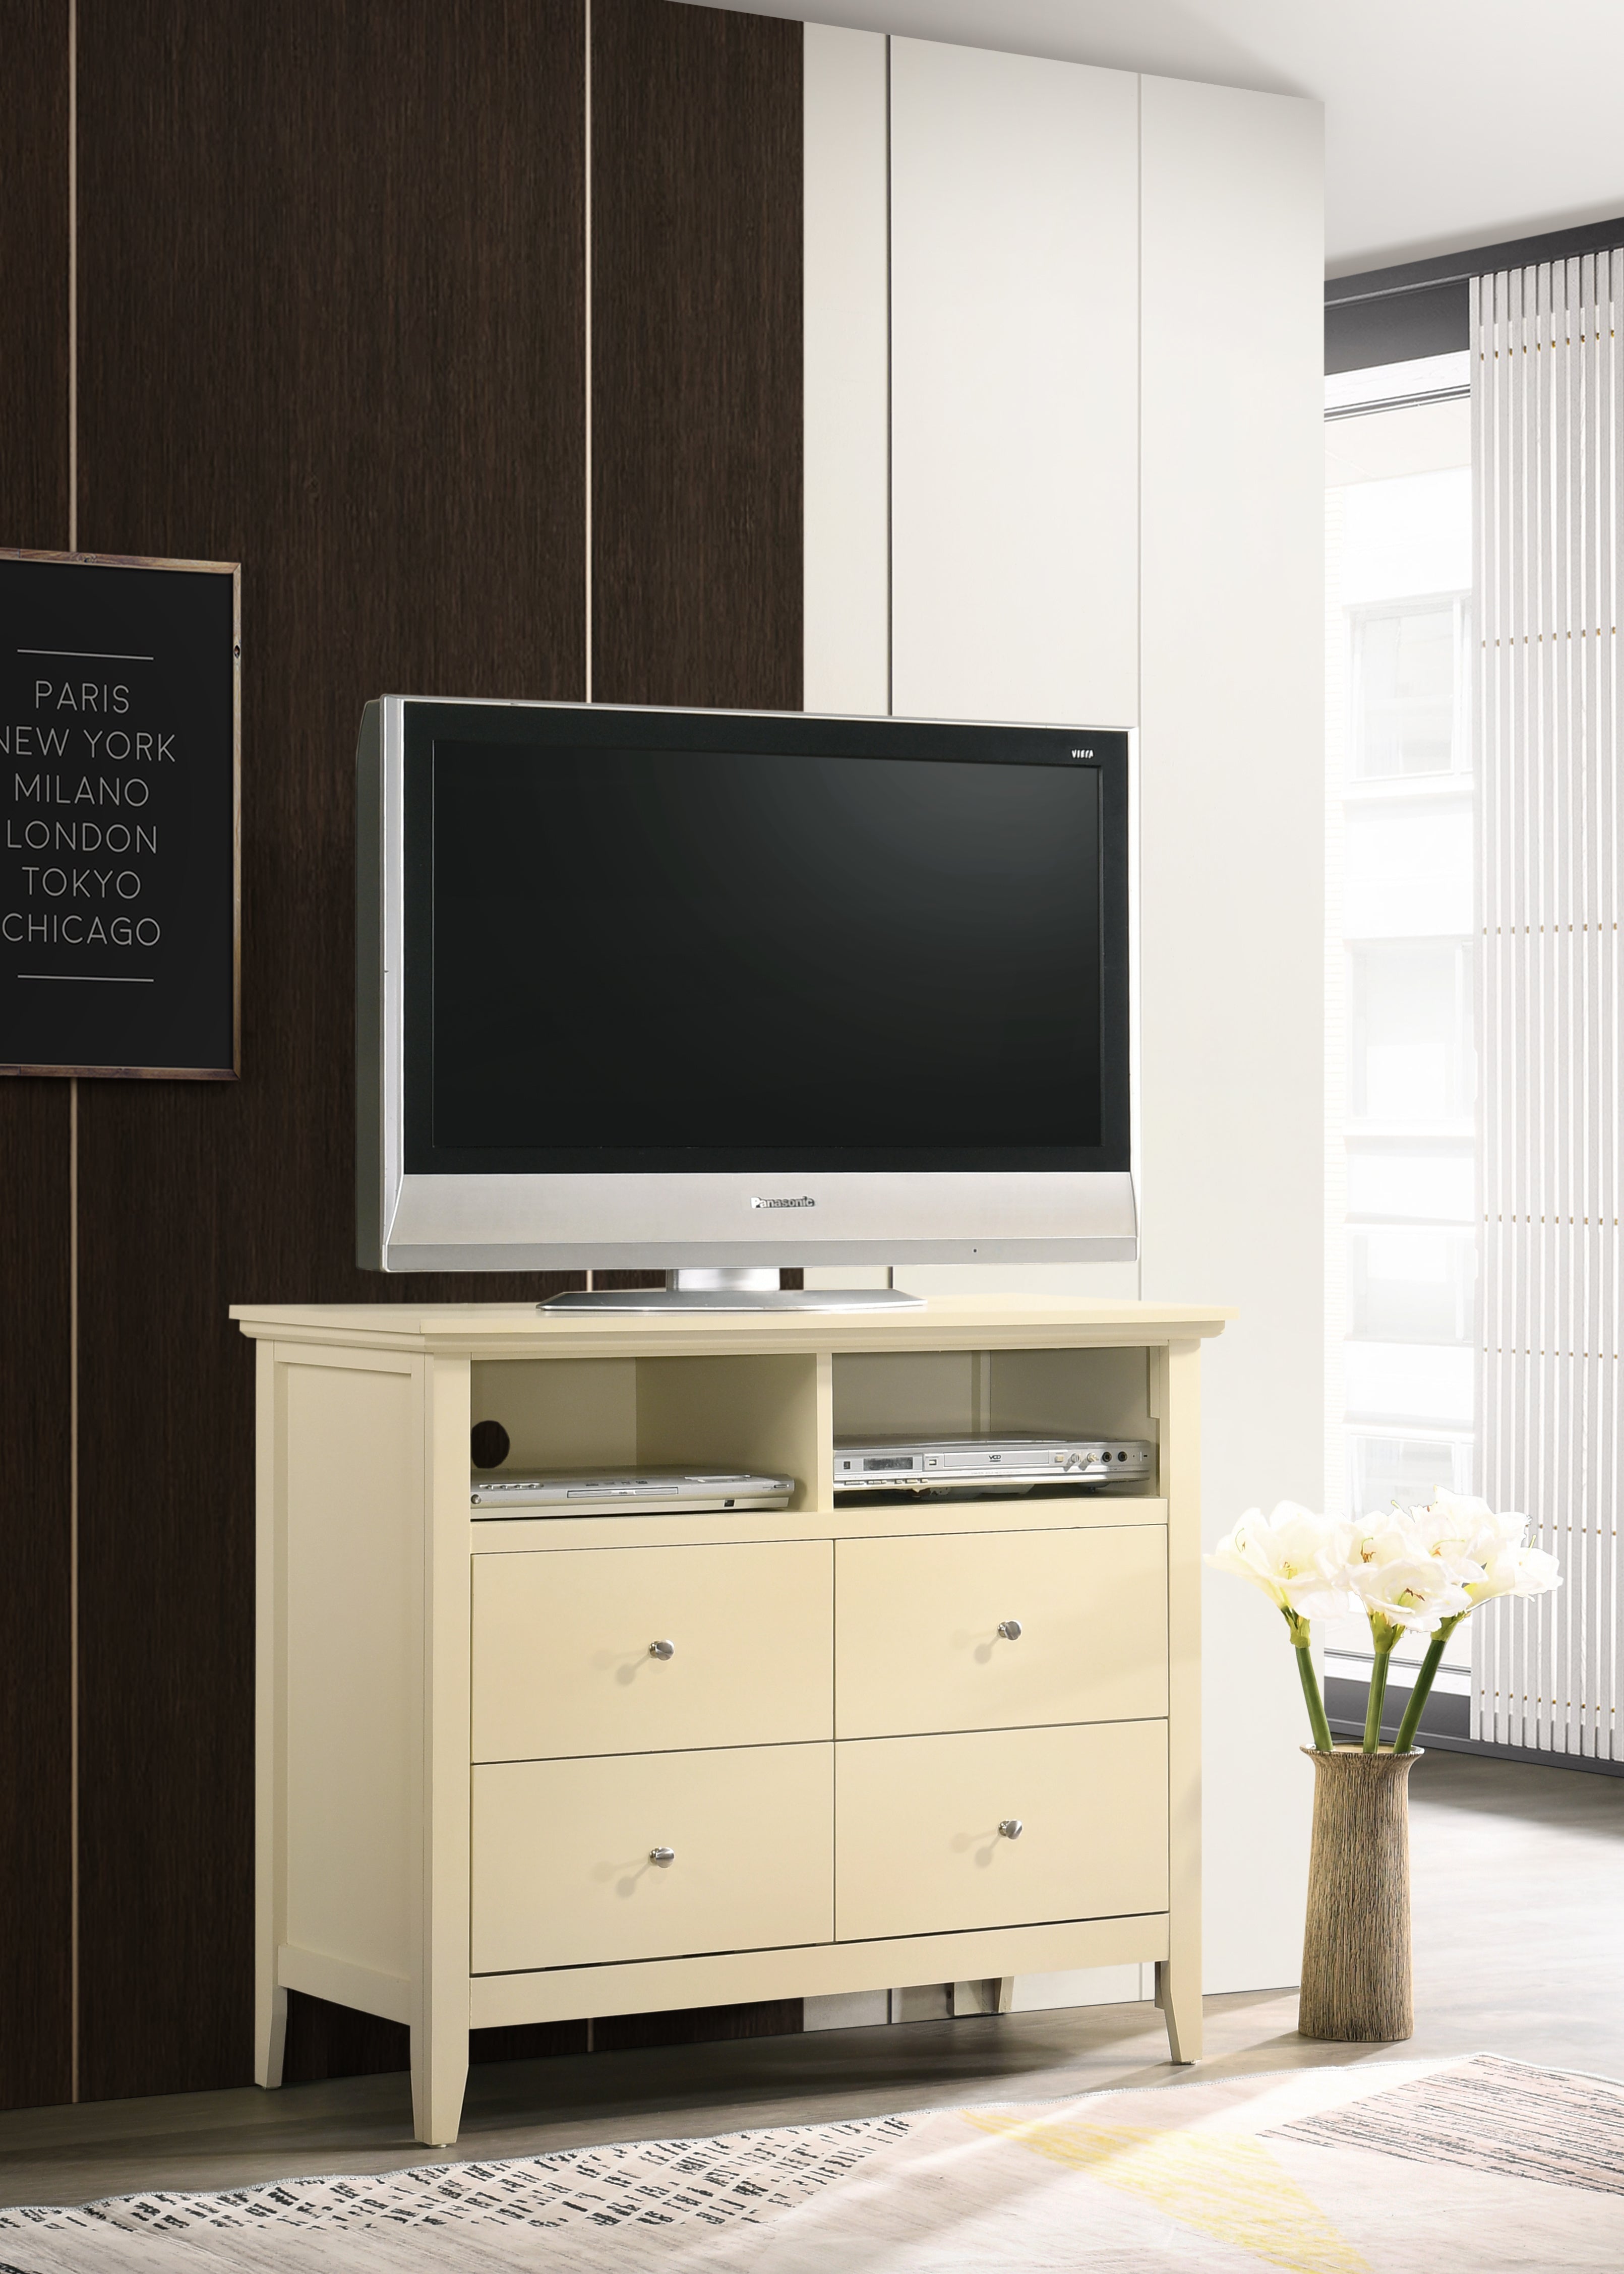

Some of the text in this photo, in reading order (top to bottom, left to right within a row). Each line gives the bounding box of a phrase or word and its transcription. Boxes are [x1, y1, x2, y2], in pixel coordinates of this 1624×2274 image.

[36, 680, 130, 713] PARIS
[83, 730, 176, 762] YORK
[15, 773, 149, 807] MILANO
[8, 819, 157, 854] LONDON
[22, 867, 141, 899] TOKYO
[2, 913, 161, 946] CHICAGO
[751, 1196, 815, 1209] Panasonic
